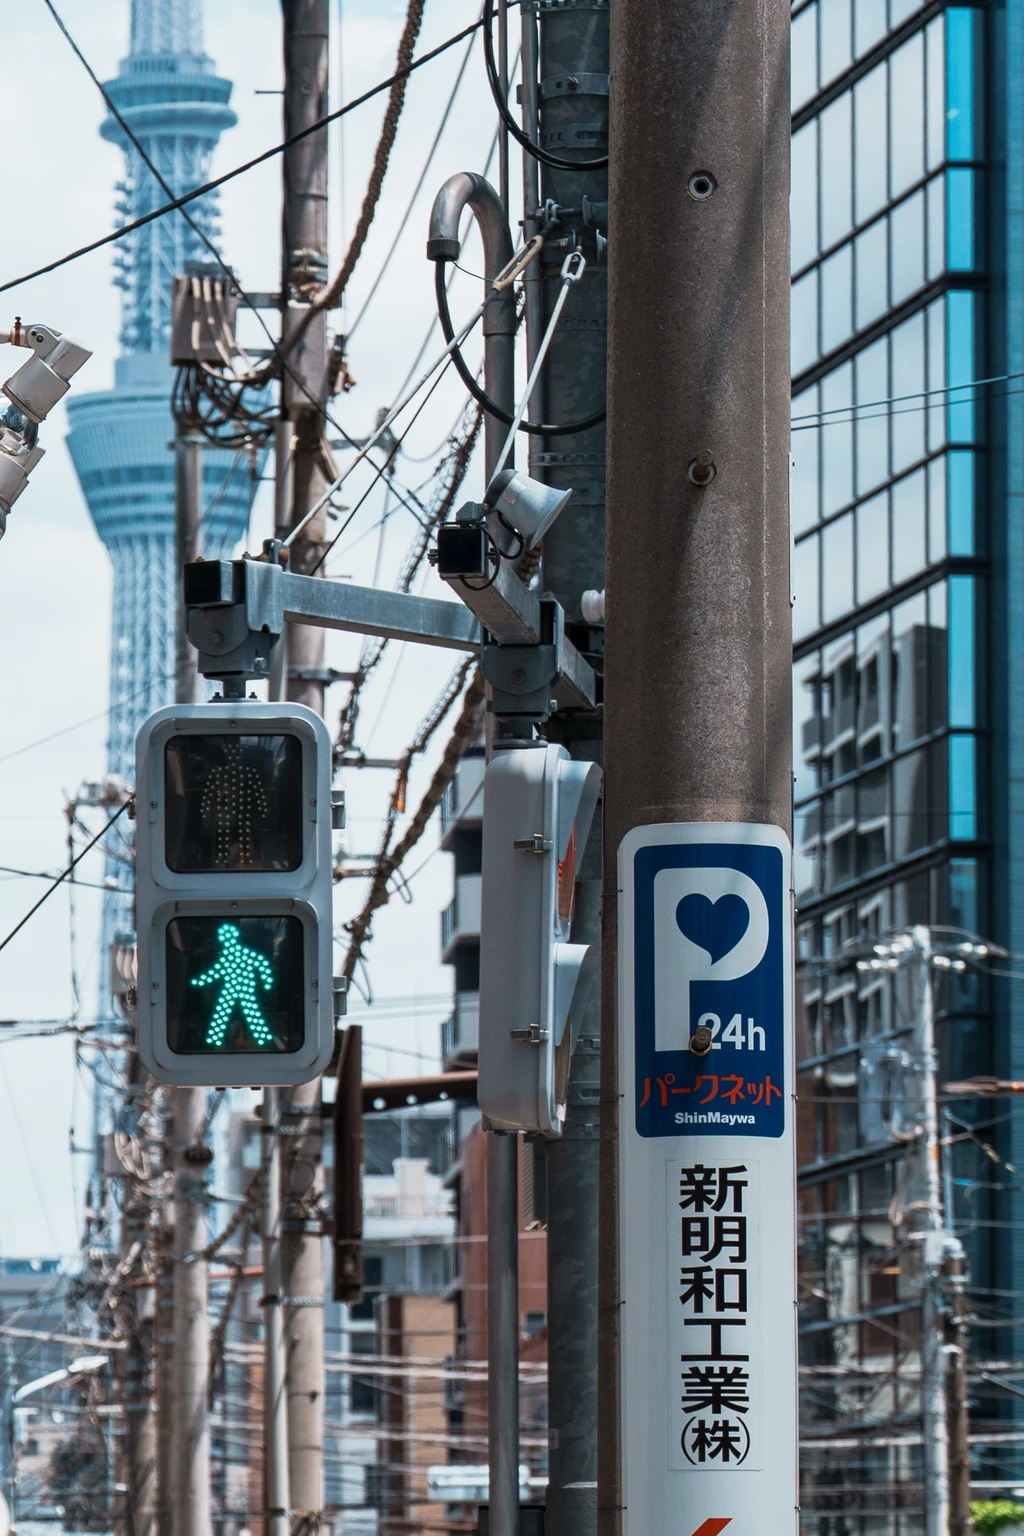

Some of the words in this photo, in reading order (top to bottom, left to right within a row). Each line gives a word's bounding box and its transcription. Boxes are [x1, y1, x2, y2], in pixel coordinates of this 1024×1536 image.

[696, 1012, 766, 1051] 24h
[639, 1073, 783, 1108] パークネット
[674, 1112, 756, 1126] ShinMaywa
